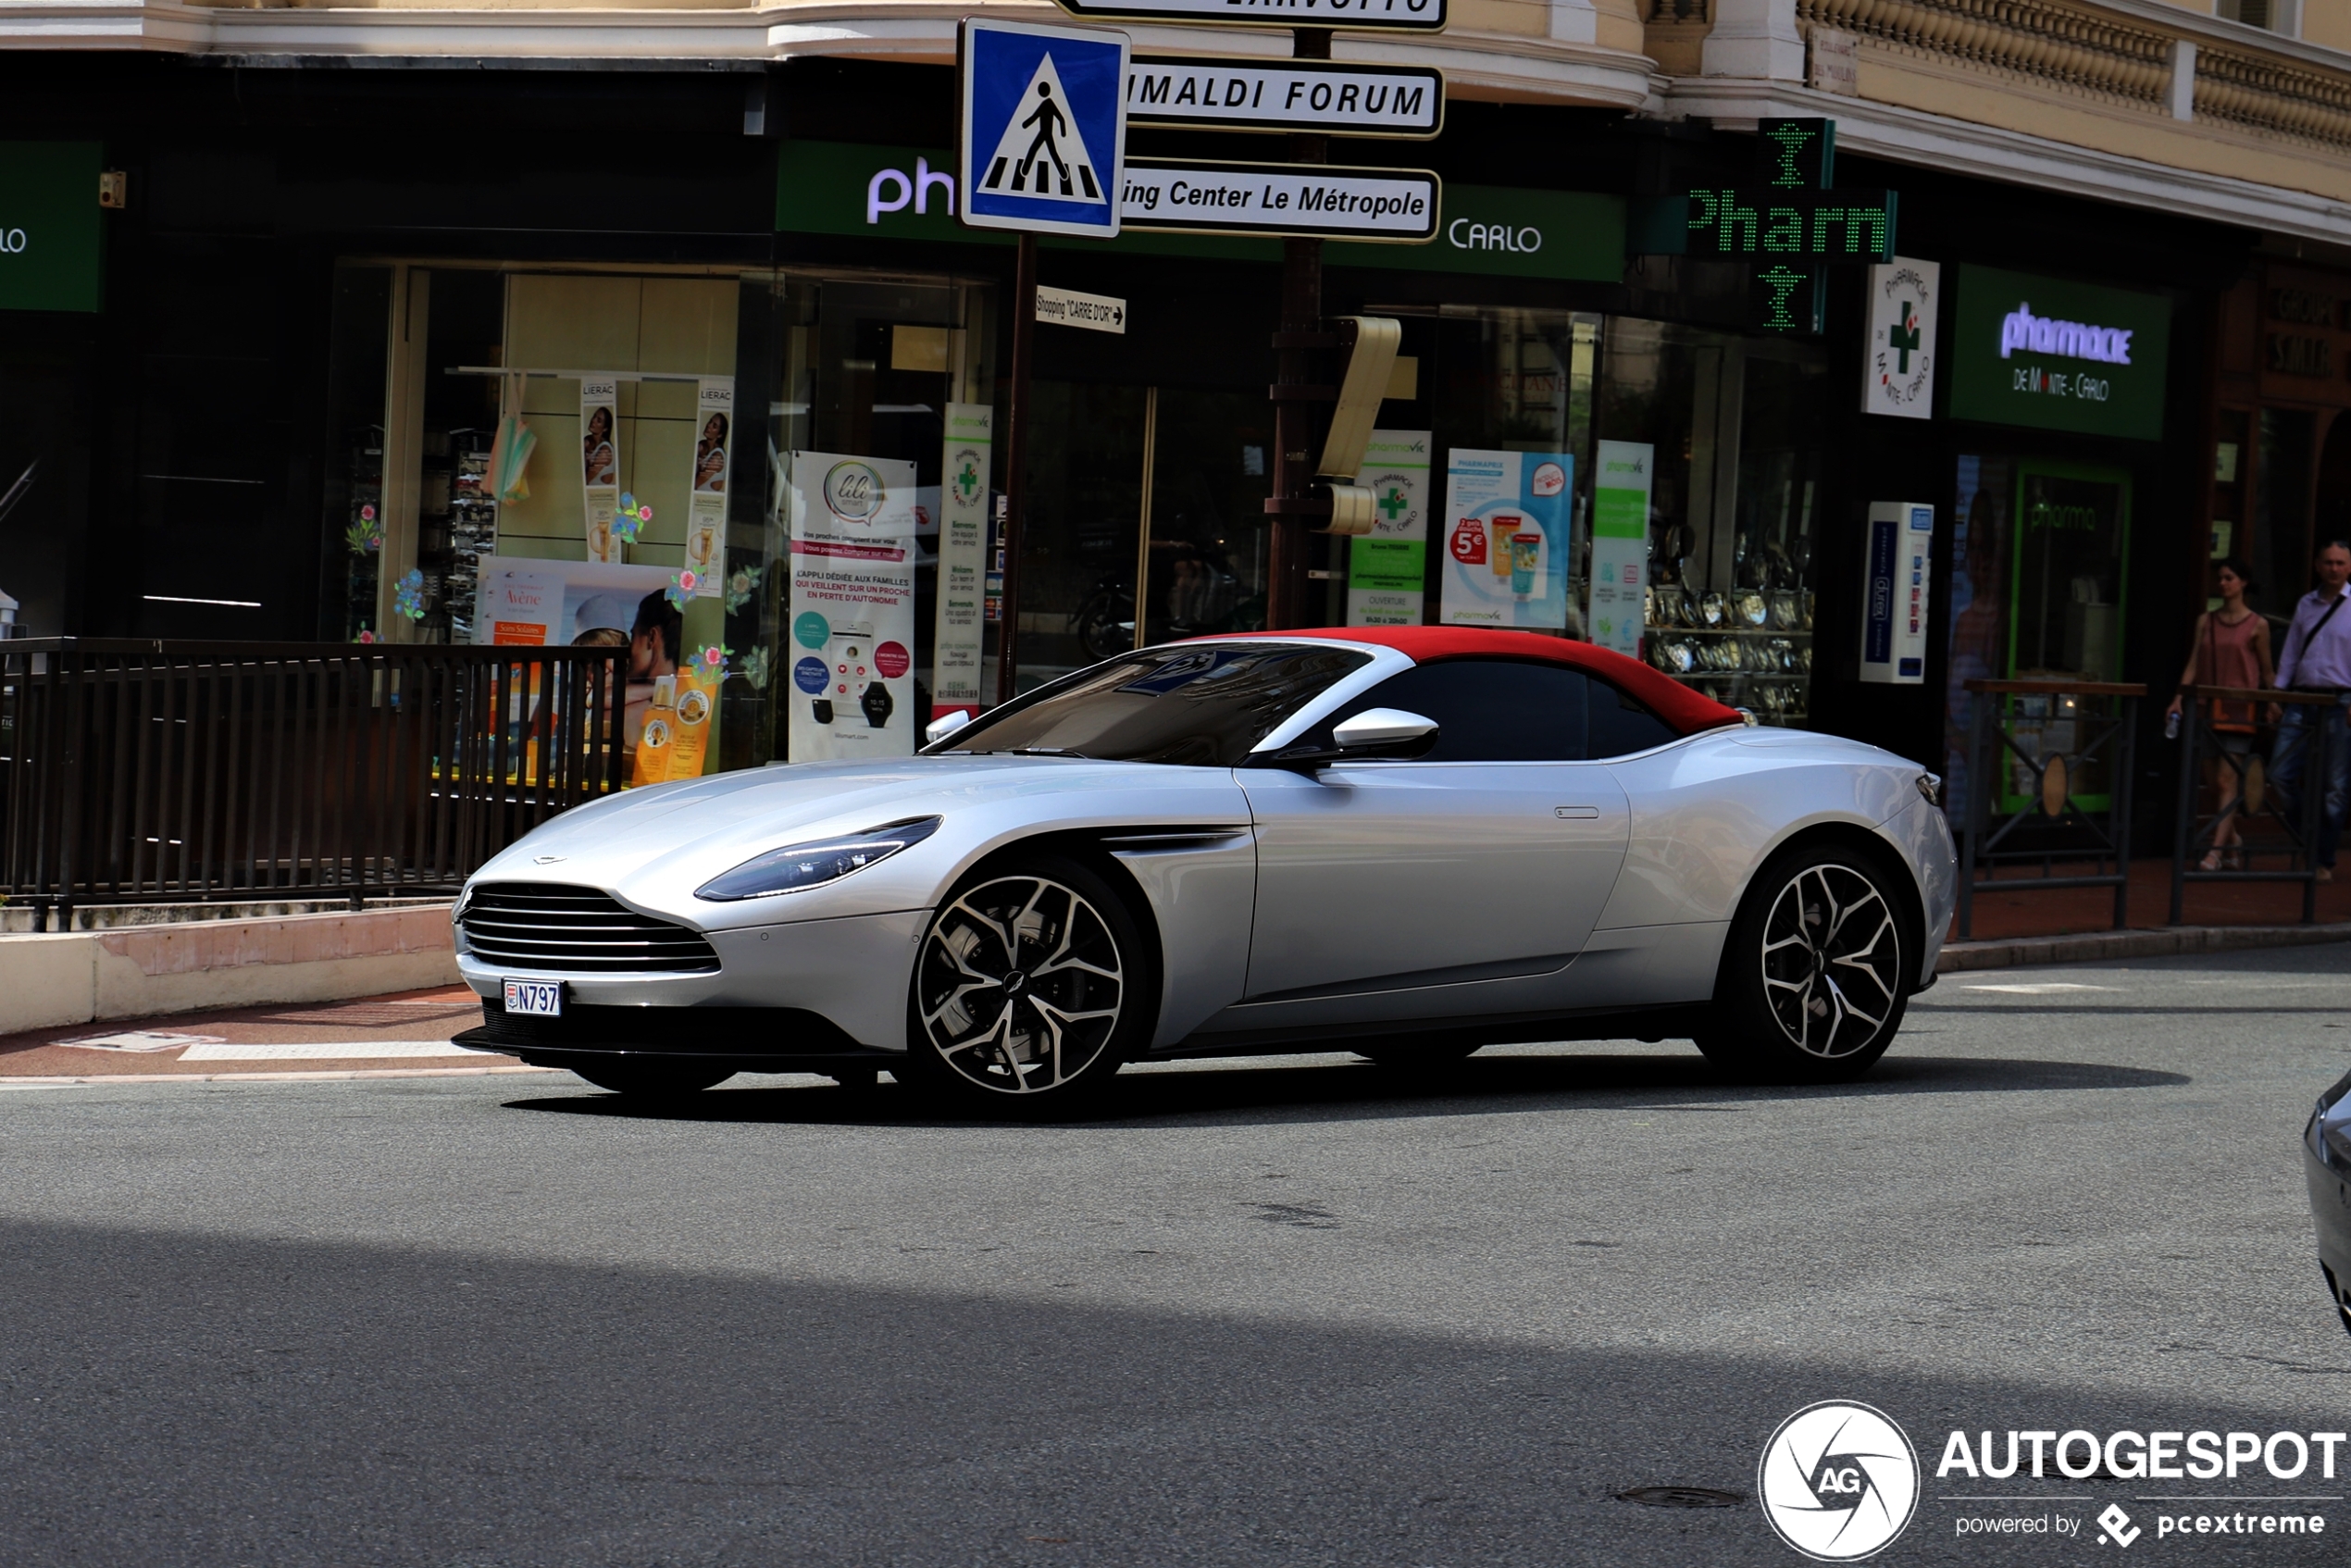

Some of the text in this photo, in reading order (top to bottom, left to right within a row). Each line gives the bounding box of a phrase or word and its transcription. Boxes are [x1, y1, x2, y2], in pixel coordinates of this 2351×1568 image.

[1285, 81, 1424, 116] FORUM
[1170, 180, 1251, 208] Center
[1262, 184, 1288, 209] Le
[1298, 186, 1424, 219] Métropole
[1449, 218, 1542, 253] CARLO
[1885, 268, 1929, 305] PHARMACIE
[1037, 293, 1065, 320] Shopping
[2000, 301, 2133, 366] pharmacie
[583, 385, 613, 395] LIERAC
[701, 390, 731, 401] LIERAC
[838, 475, 869, 500] lili
[1374, 473, 1413, 490] PHARMACIE
[815, 532, 840, 541] proches
[803, 544, 820, 553] Vous
[843, 549, 872, 557] compter
[797, 570, 909, 587] L'APPLI DÉDIÉE AUX FAMILLES
[795, 579, 810, 589] QUI
[810, 581, 847, 591] VEILLENT
[848, 584, 865, 593] SUR
[878, 587, 911, 597] PROCHE
[504, 589, 541, 606] Avène
[807, 591, 899, 605] EN PERTE D'AUTONOMIE
[1369, 596, 1406, 606] OUVERTURE
[1875, 579, 1889, 617] durex
[500, 623, 540, 635] Soins Solaires
[519, 985, 557, 1012] N797
